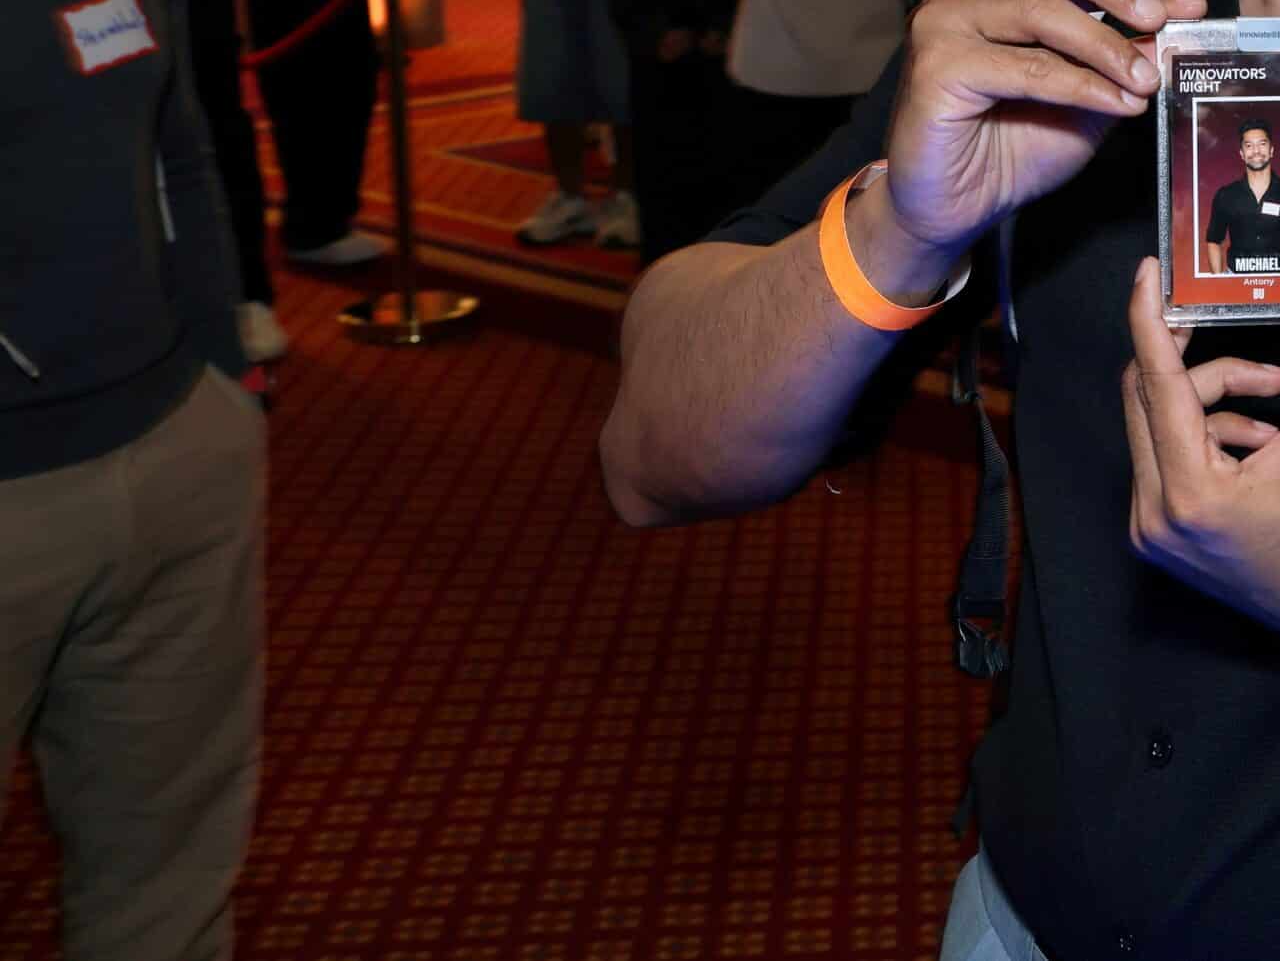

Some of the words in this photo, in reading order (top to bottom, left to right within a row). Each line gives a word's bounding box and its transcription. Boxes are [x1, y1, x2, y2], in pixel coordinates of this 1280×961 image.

[1179, 68, 1266, 80] INNOVATORS
[1179, 81, 1221, 93] NIGHT
[1235, 258, 1280, 271] MICHAEL
[1243, 279, 1274, 287] Antony
[1253, 288, 1264, 299] BU
